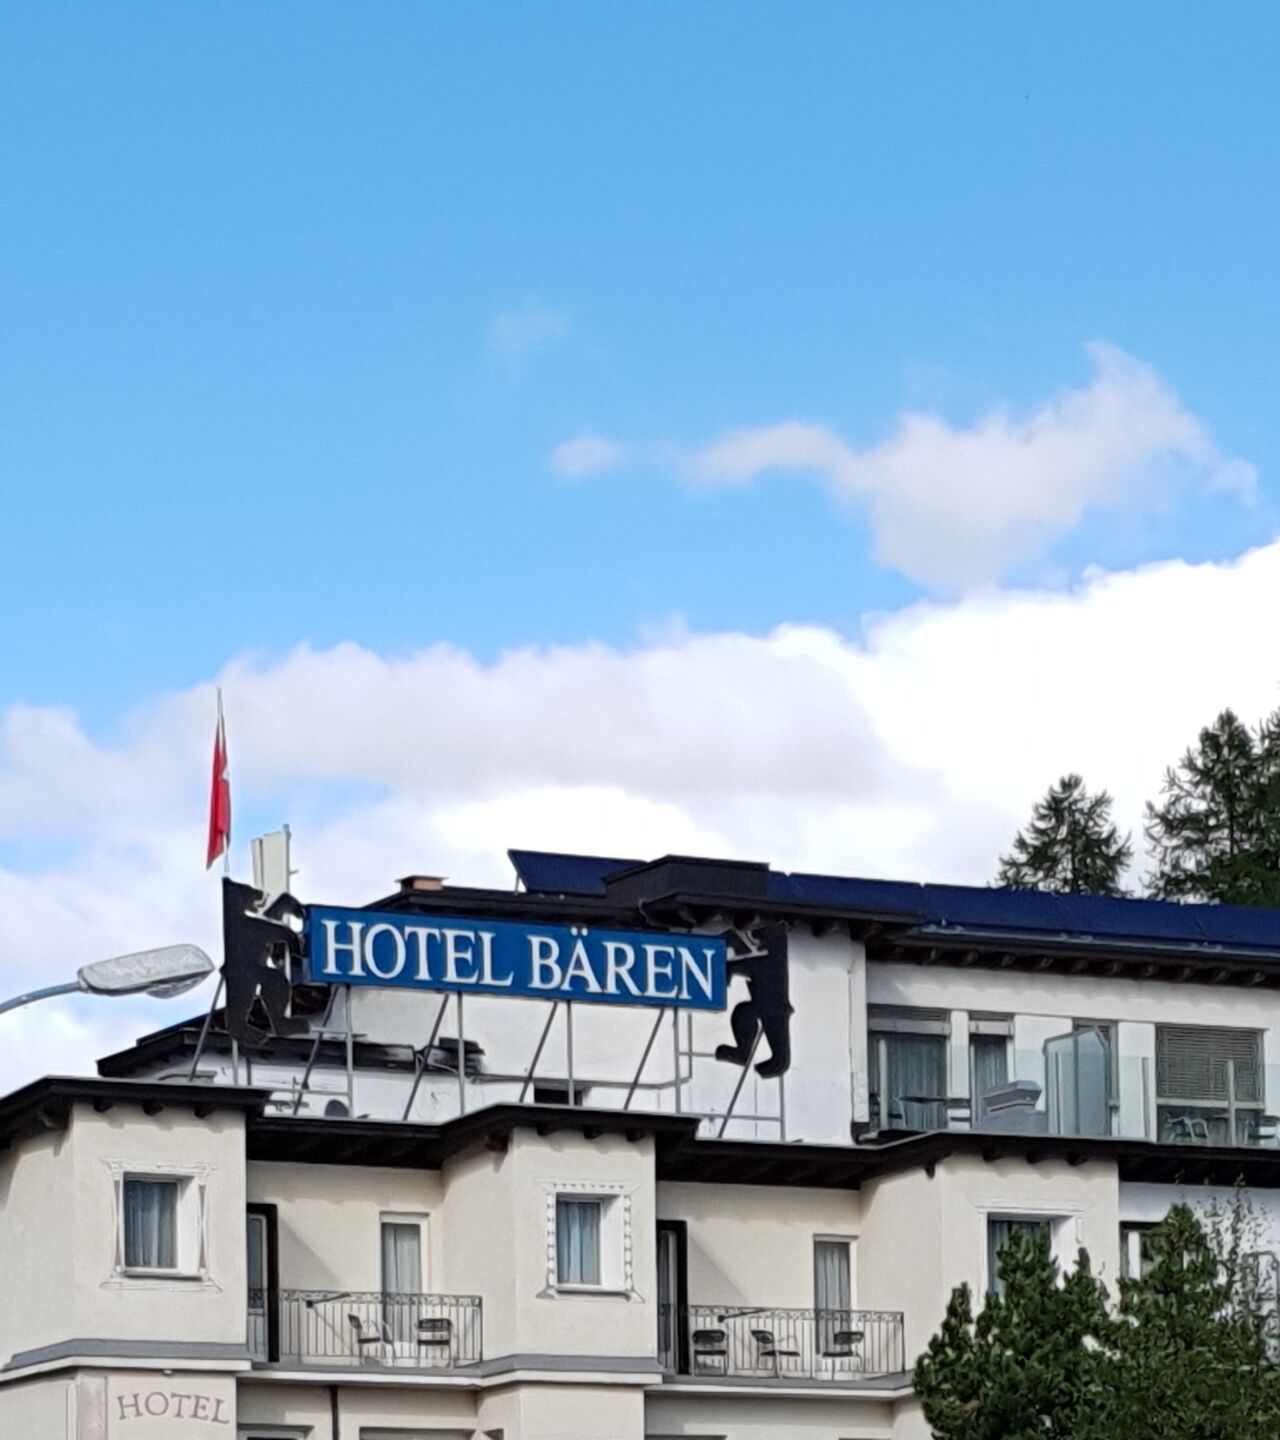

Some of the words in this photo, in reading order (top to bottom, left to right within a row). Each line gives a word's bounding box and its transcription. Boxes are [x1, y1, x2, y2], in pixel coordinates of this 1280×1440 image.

[320, 918, 514, 988] HOTEL
[527, 926, 716, 1001] BÄREN
[116, 1391, 231, 1425] HOTEL
